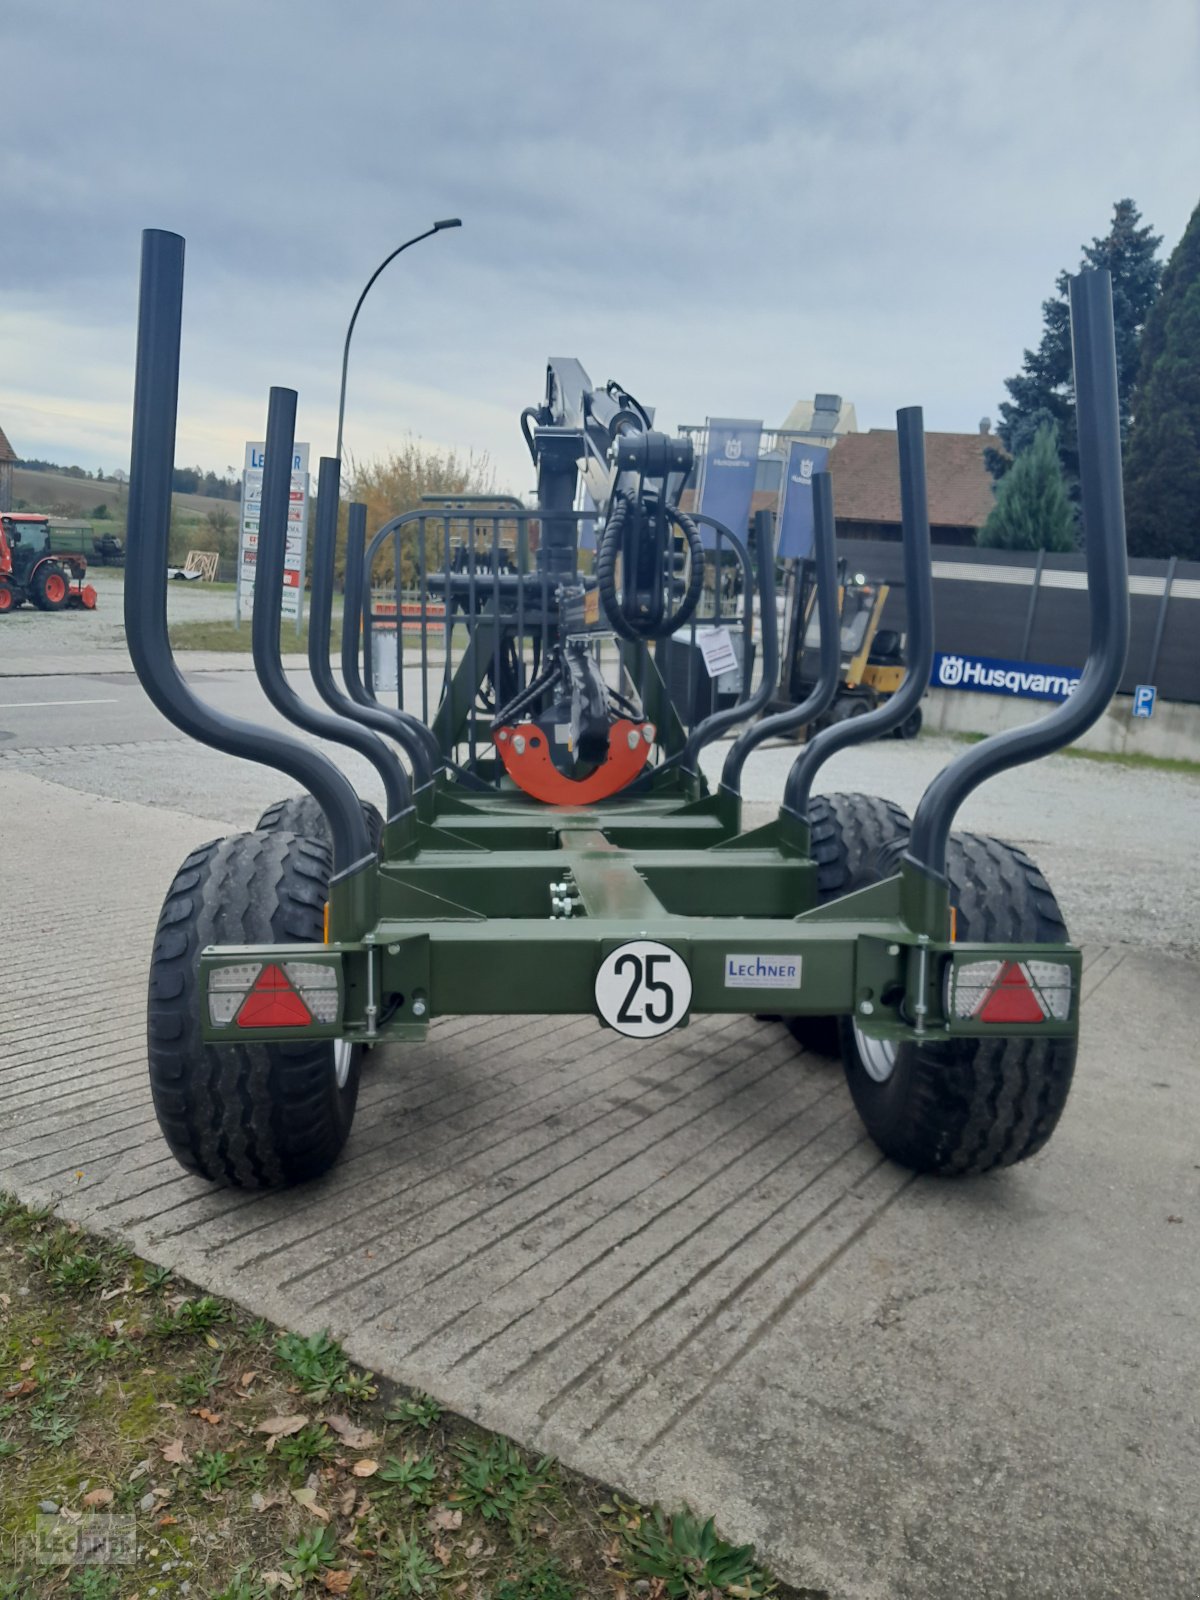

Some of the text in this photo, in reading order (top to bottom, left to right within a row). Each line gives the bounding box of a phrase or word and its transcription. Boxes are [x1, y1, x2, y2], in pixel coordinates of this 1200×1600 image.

[962, 661, 1081, 697] Husqvarna
[1138, 688, 1153, 707] P
[614, 953, 674, 1024] 25
